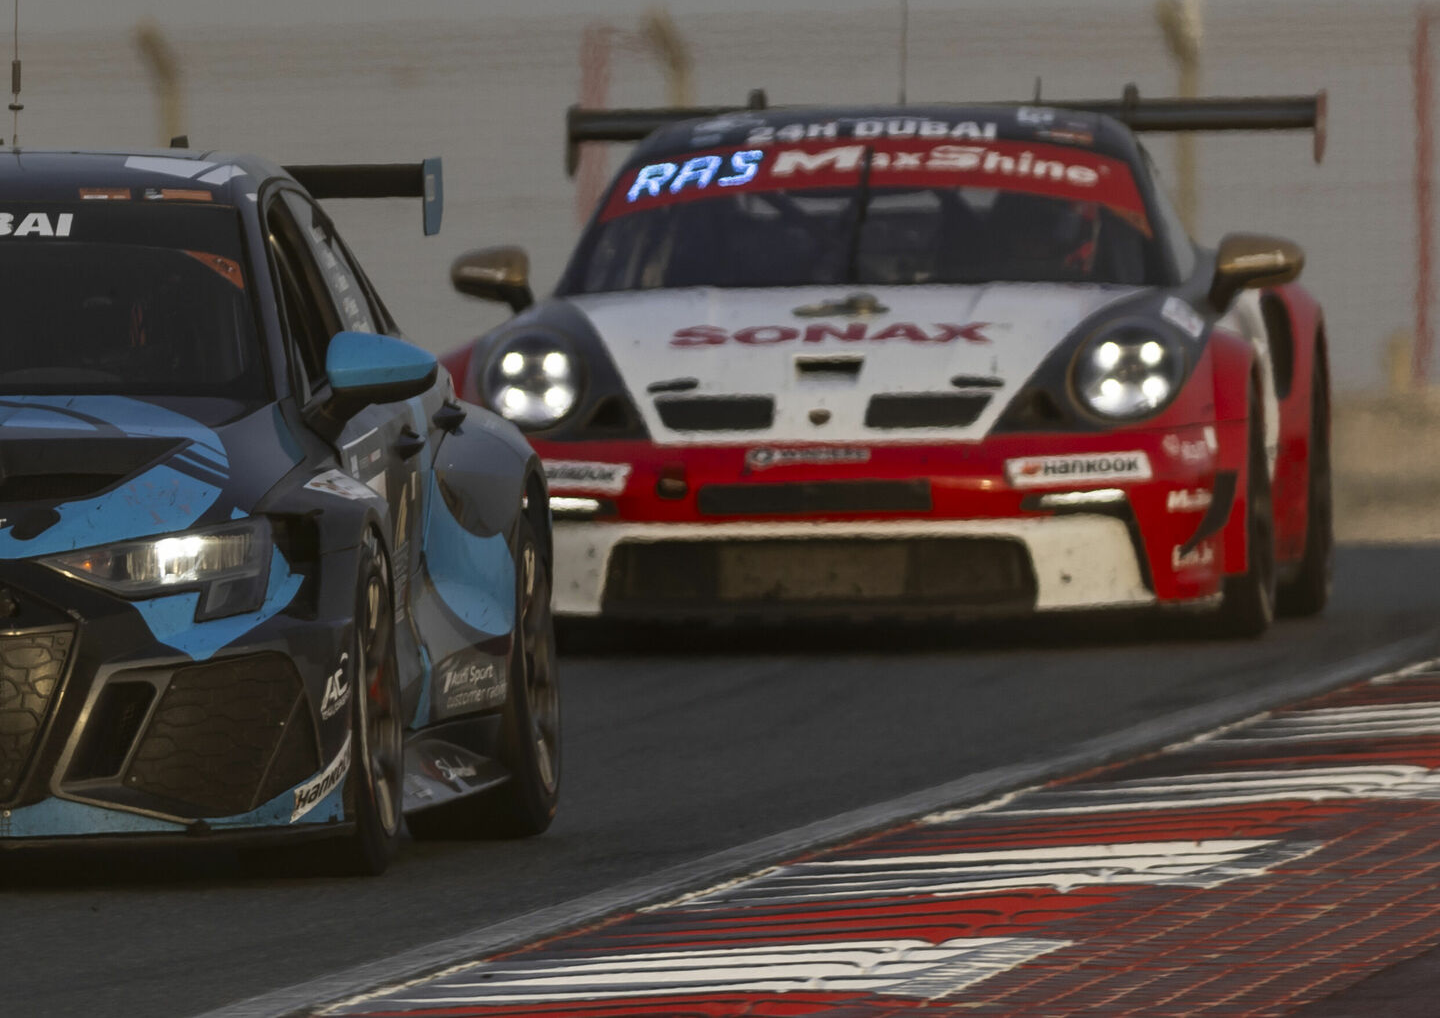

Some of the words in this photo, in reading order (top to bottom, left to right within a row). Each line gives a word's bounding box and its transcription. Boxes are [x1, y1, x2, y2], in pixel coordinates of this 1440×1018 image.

[747, 122, 838, 143] 24H
[854, 119, 998, 139] DUBAI
[627, 150, 763, 202] RAS
[668, 322, 993, 349] SONAX
